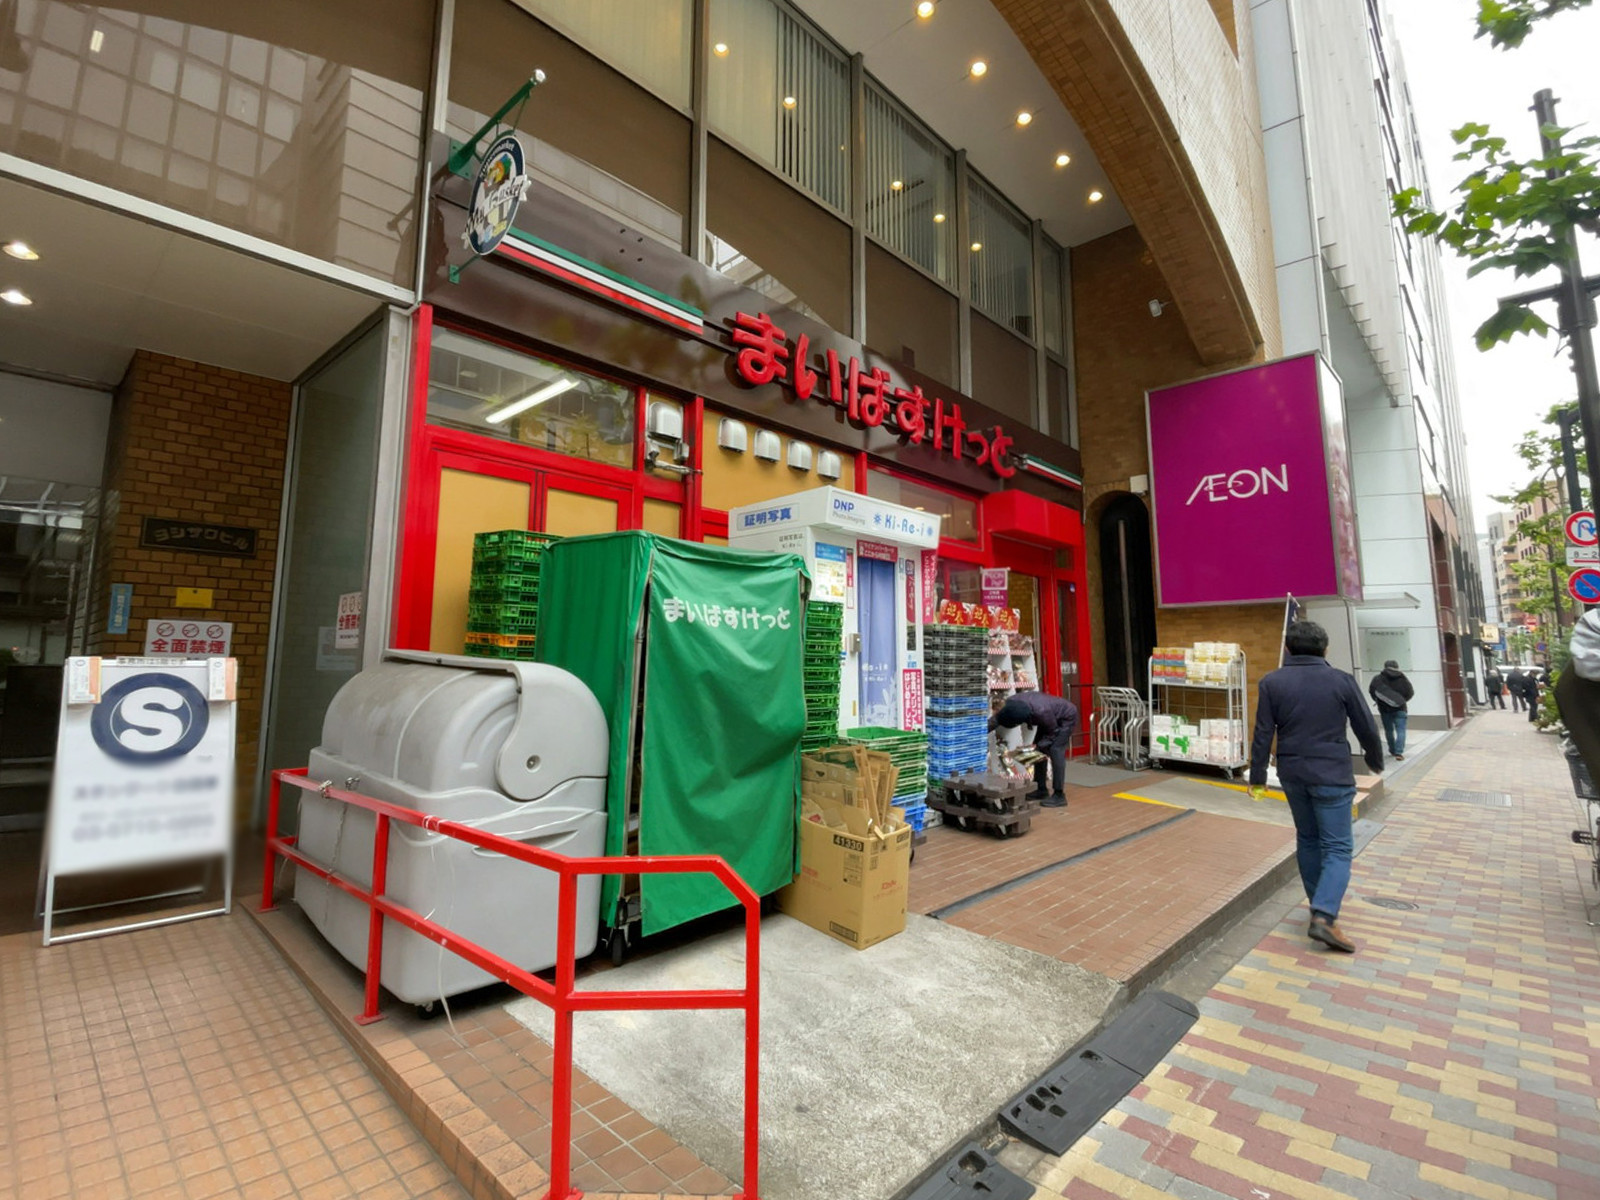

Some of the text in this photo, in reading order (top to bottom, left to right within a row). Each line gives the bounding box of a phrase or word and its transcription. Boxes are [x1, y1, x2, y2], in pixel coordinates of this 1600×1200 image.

[733, 311, 1016, 478] まいばすけっと
[833, 499, 855, 512] DNP
[744, 507, 792, 527] 証明写真
[663, 597, 791, 630] まいばすけっと
[151, 638, 226, 654] 全面禁煙
[904, 672, 912, 728] はじめました
[834, 837, 863, 851] 41330
